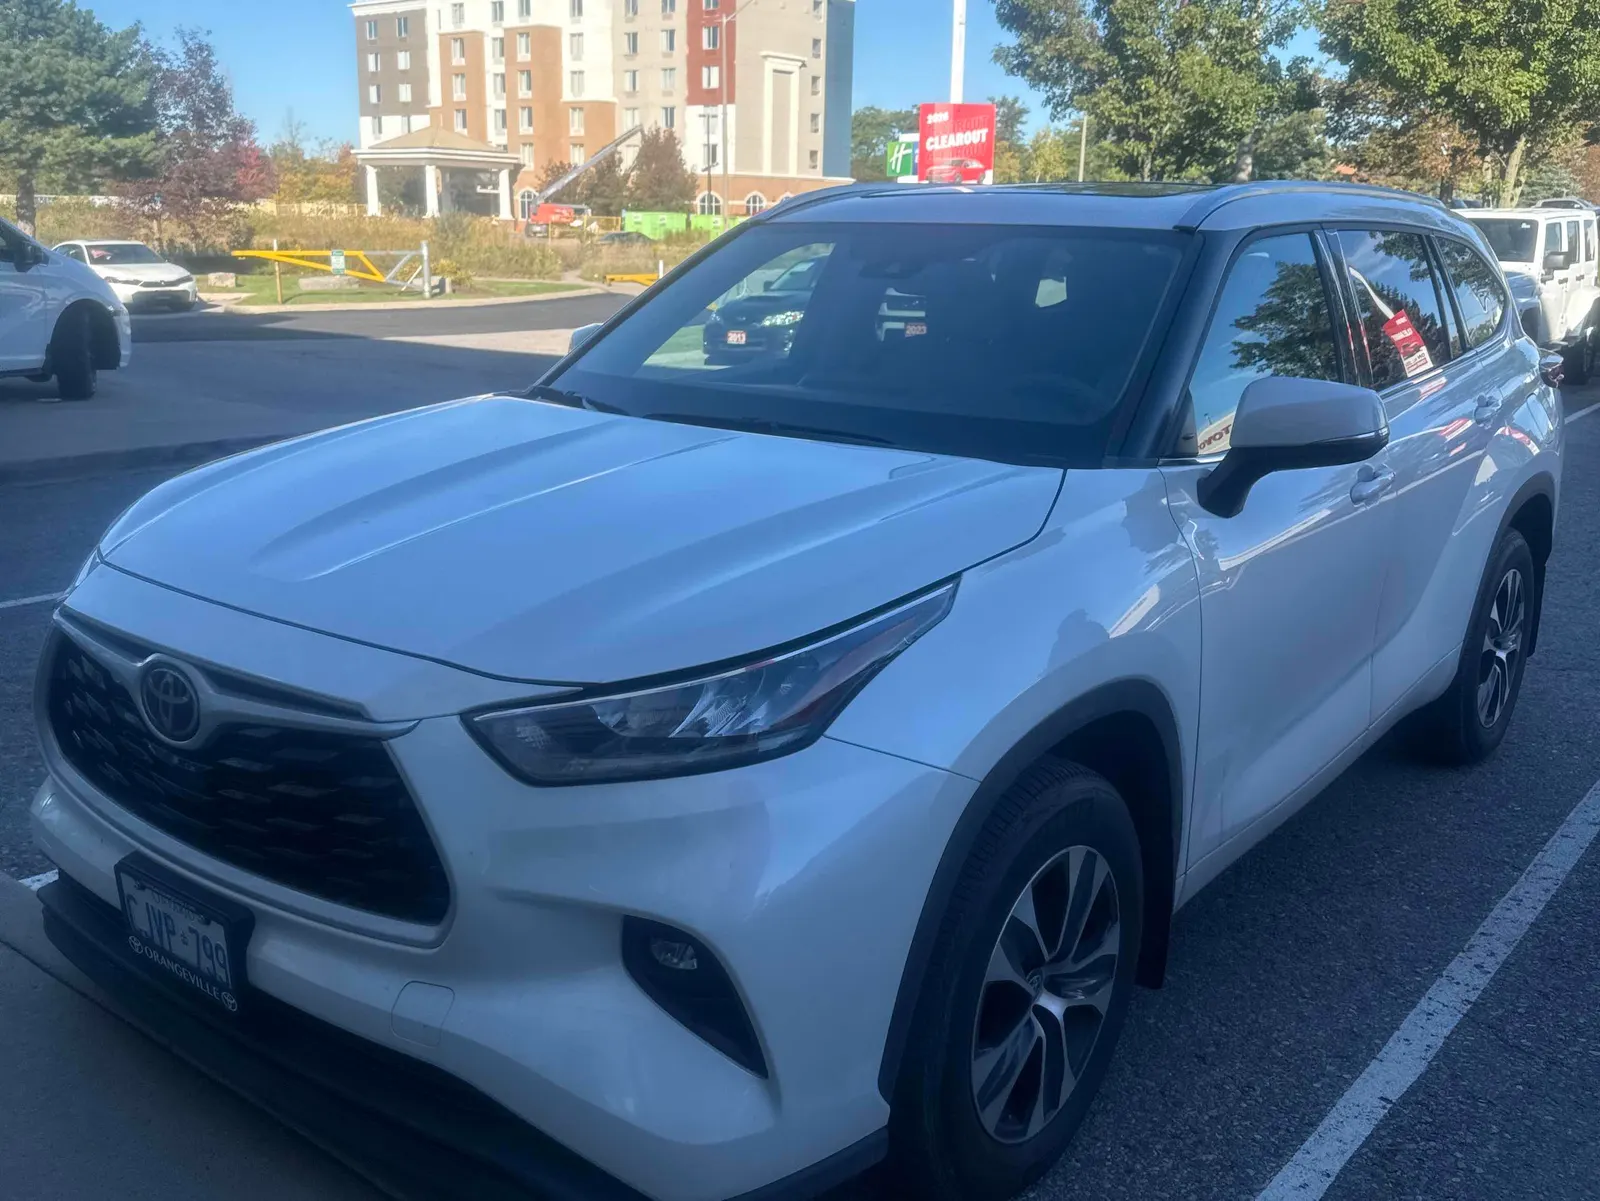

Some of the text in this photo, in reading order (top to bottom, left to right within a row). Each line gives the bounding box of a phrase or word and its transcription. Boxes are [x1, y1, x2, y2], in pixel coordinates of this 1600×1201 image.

[925, 128, 989, 152] CLEAROUT
[144, 946, 220, 1000] ORANGEVILLE
[188, 925, 231, 985] 799
